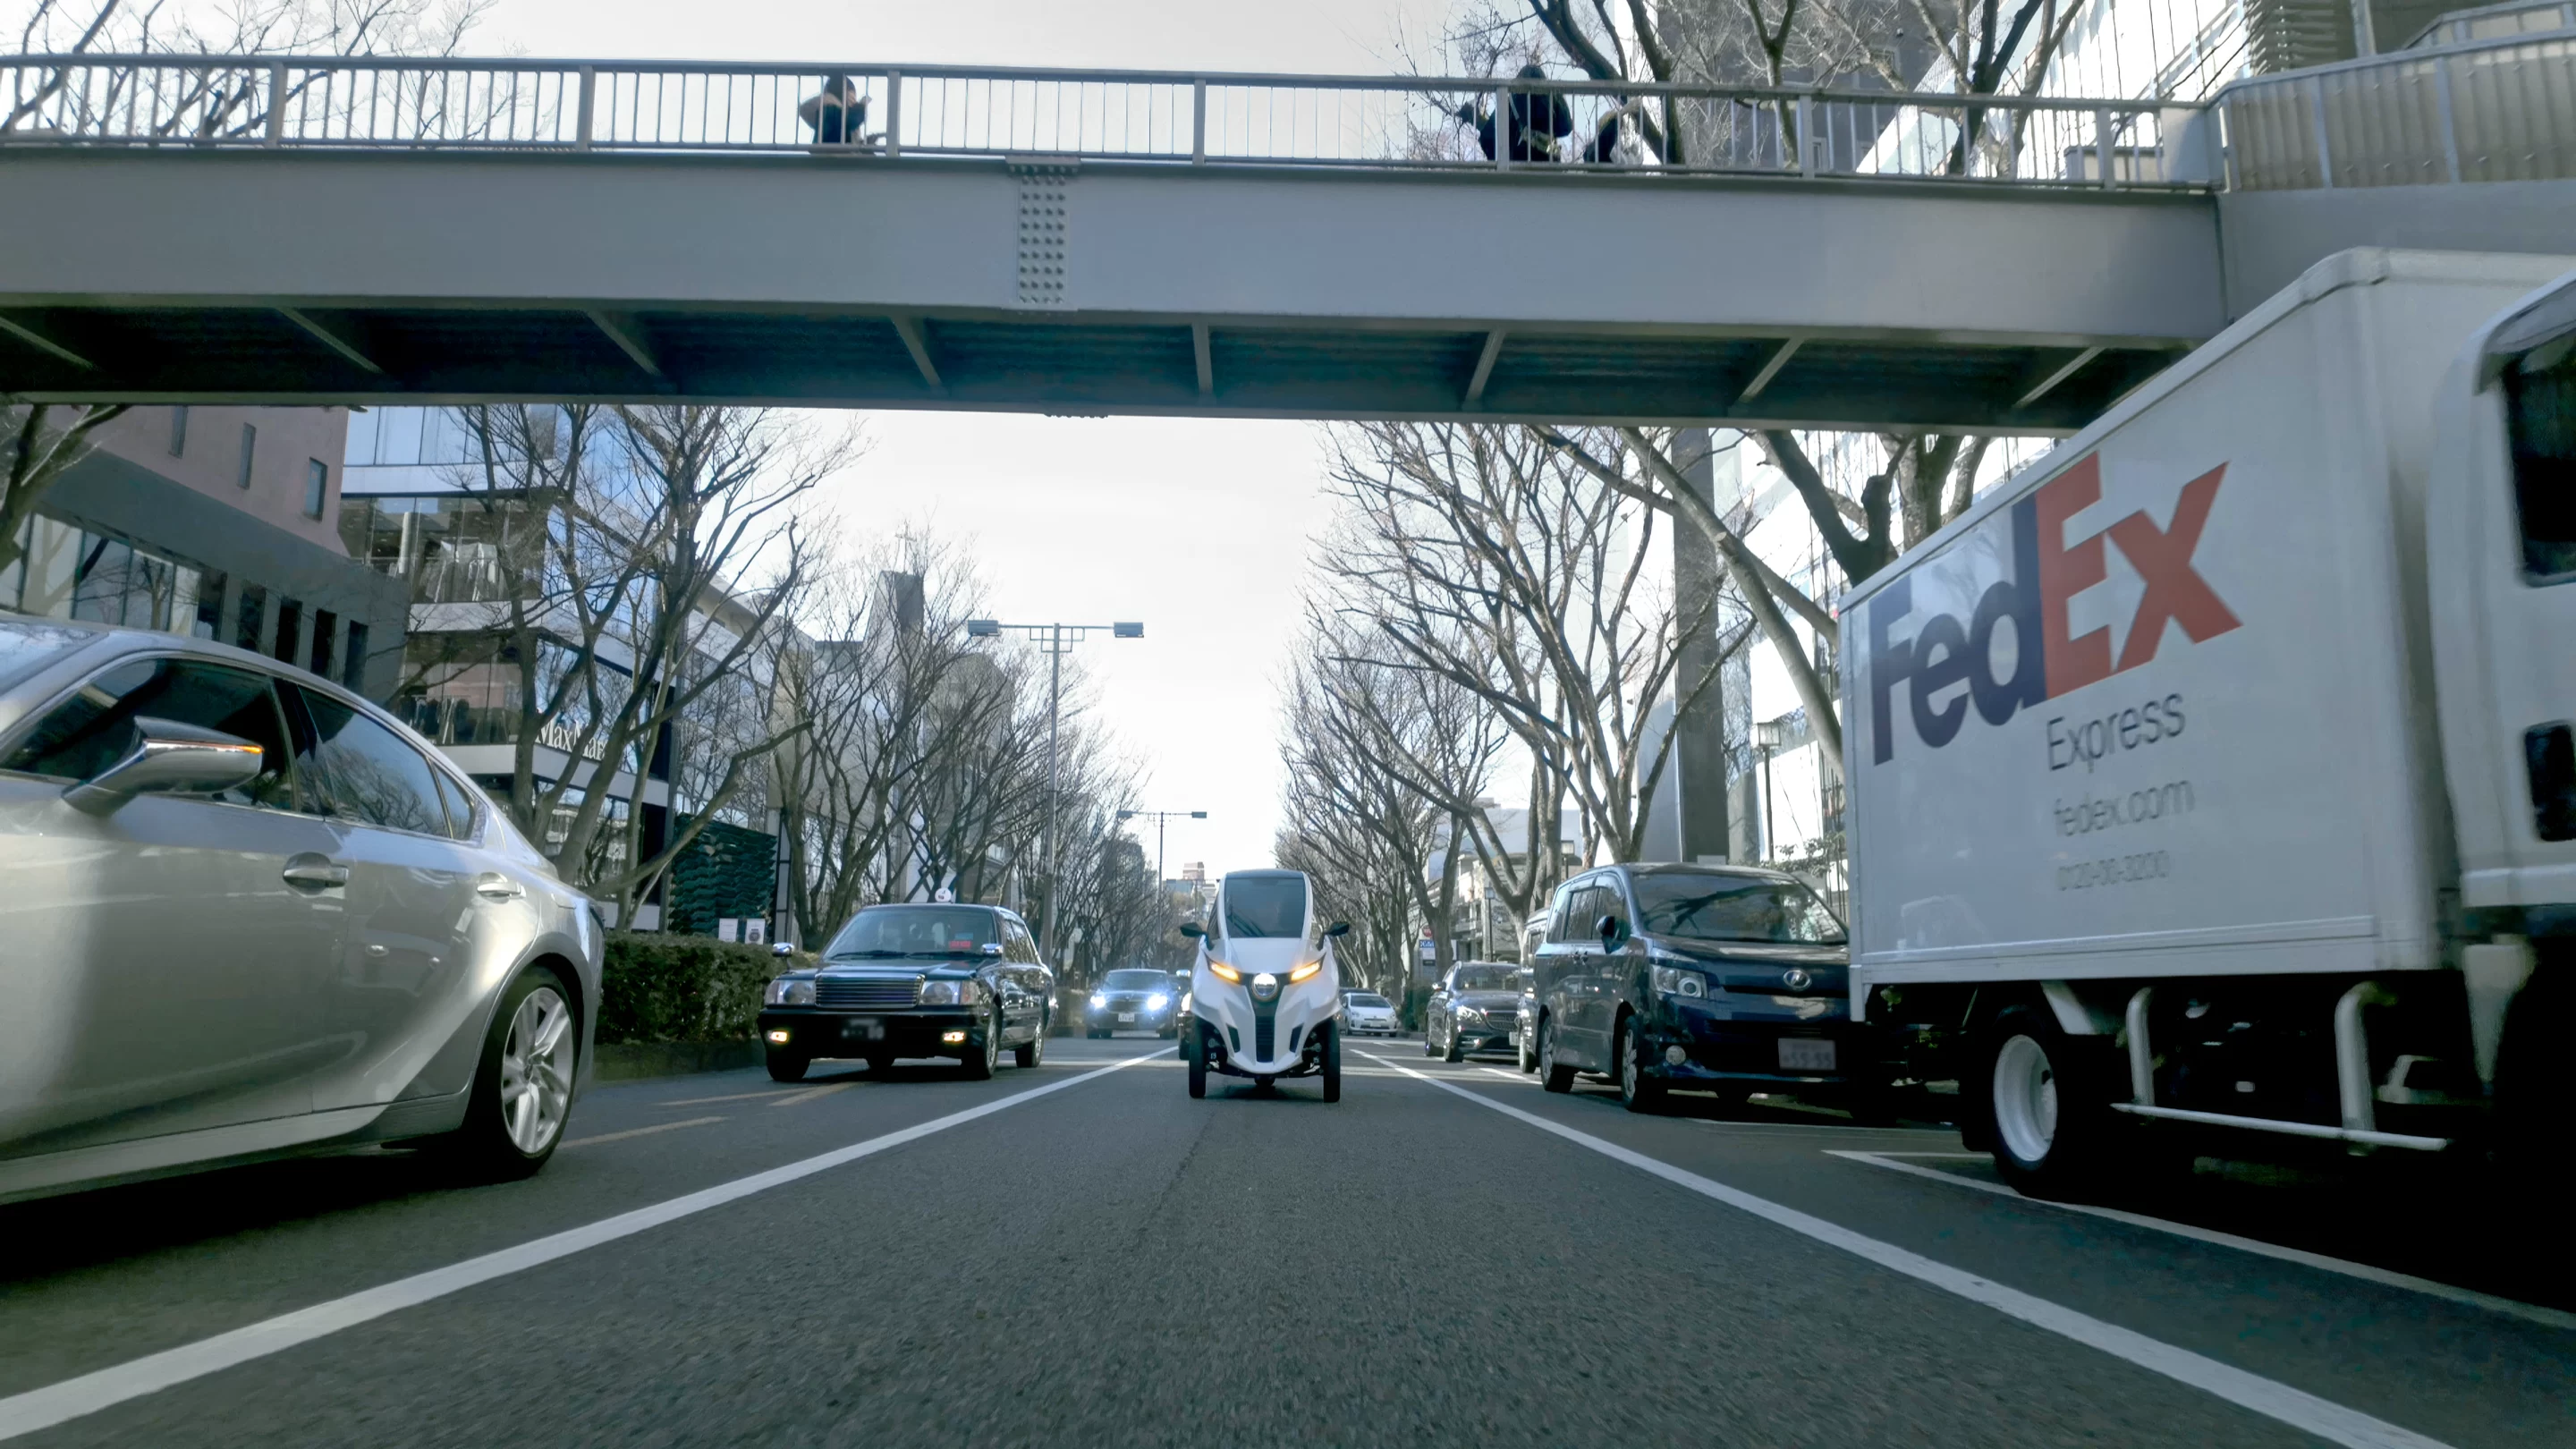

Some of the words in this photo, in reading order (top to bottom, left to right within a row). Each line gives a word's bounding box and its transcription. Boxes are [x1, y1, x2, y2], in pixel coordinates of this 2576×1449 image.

[1868, 450, 2243, 766] FedEx
[535, 712, 606, 761] MaxMar
[2047, 692, 2186, 773] Express
